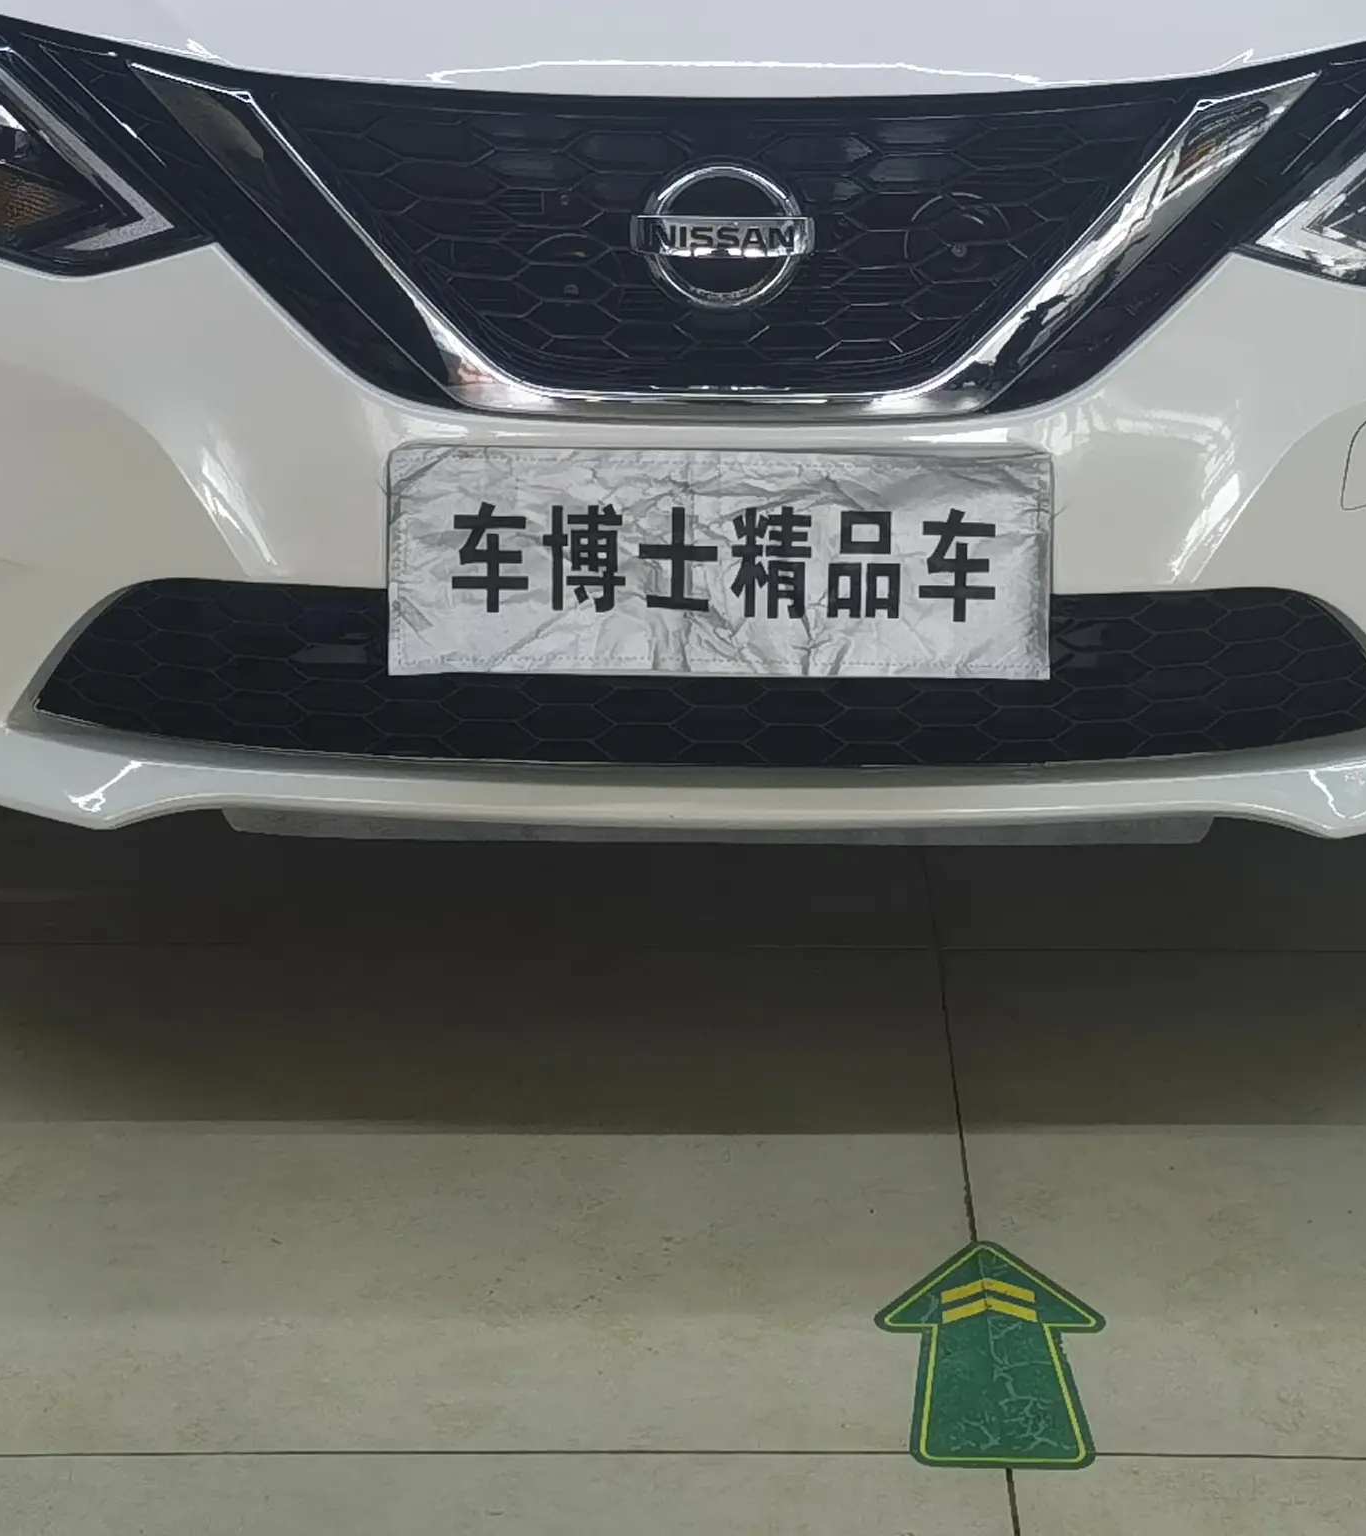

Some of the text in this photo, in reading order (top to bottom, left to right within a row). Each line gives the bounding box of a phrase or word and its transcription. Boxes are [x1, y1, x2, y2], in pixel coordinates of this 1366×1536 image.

[643, 224, 795, 251] NISSAN
[450, 502, 996, 623] 车博士精品车
